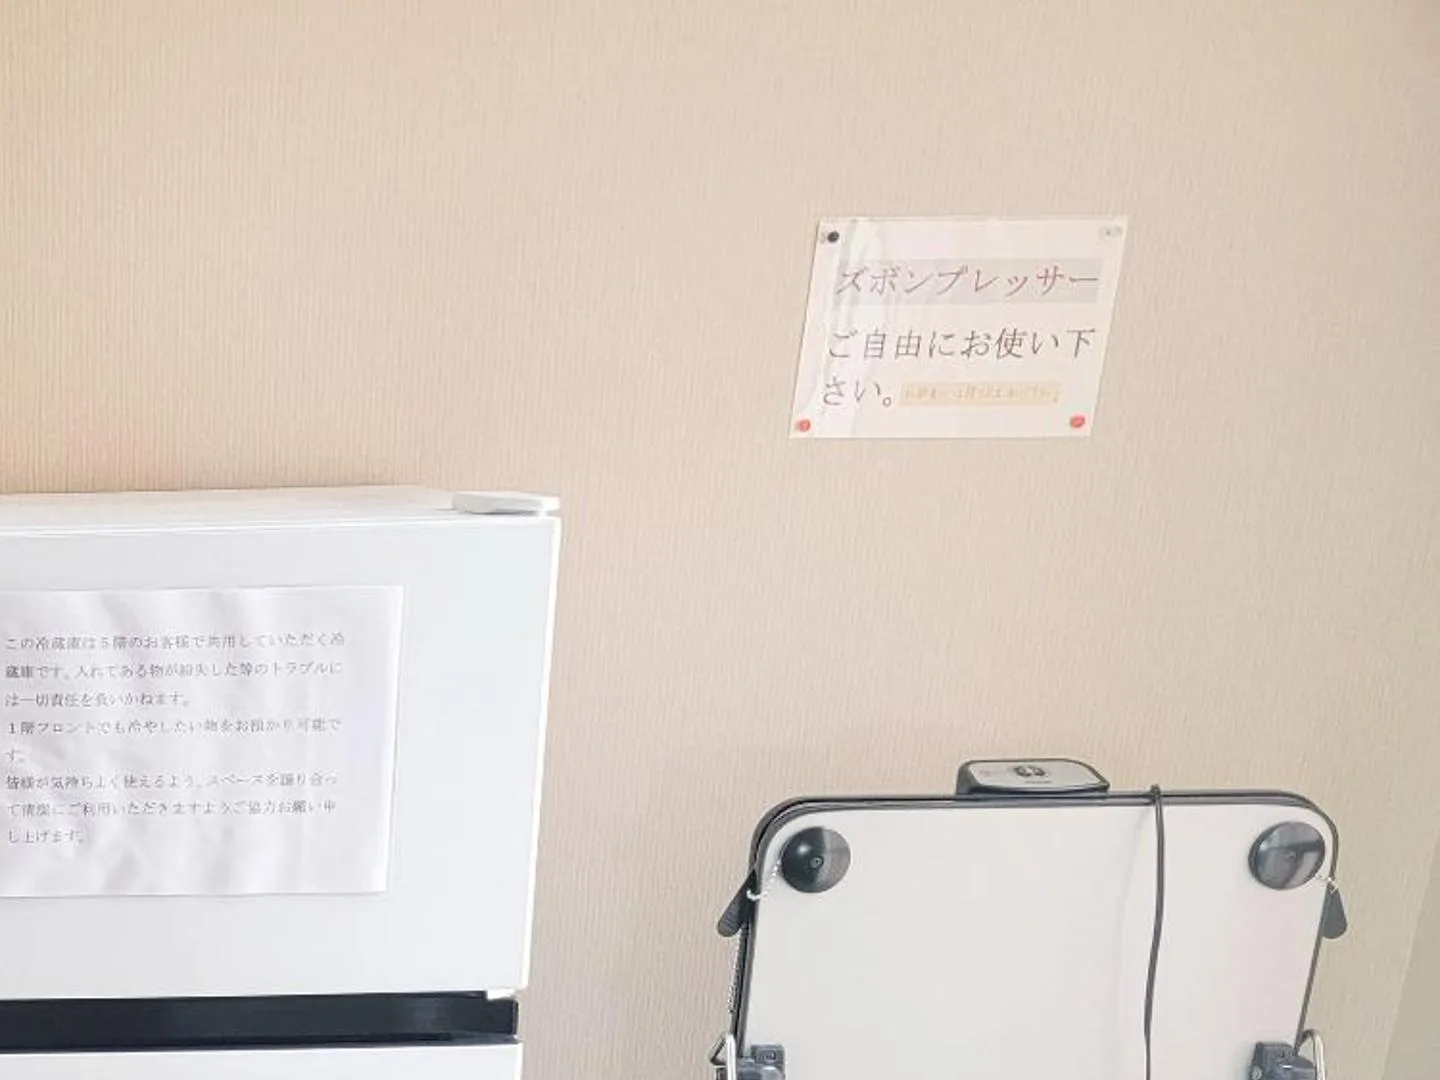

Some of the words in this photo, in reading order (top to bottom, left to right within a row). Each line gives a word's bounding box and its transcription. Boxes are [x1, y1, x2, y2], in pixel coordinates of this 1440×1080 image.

[827, 327, 1097, 361] ご自由にお使い下
[822, 375, 894, 408] さい。
